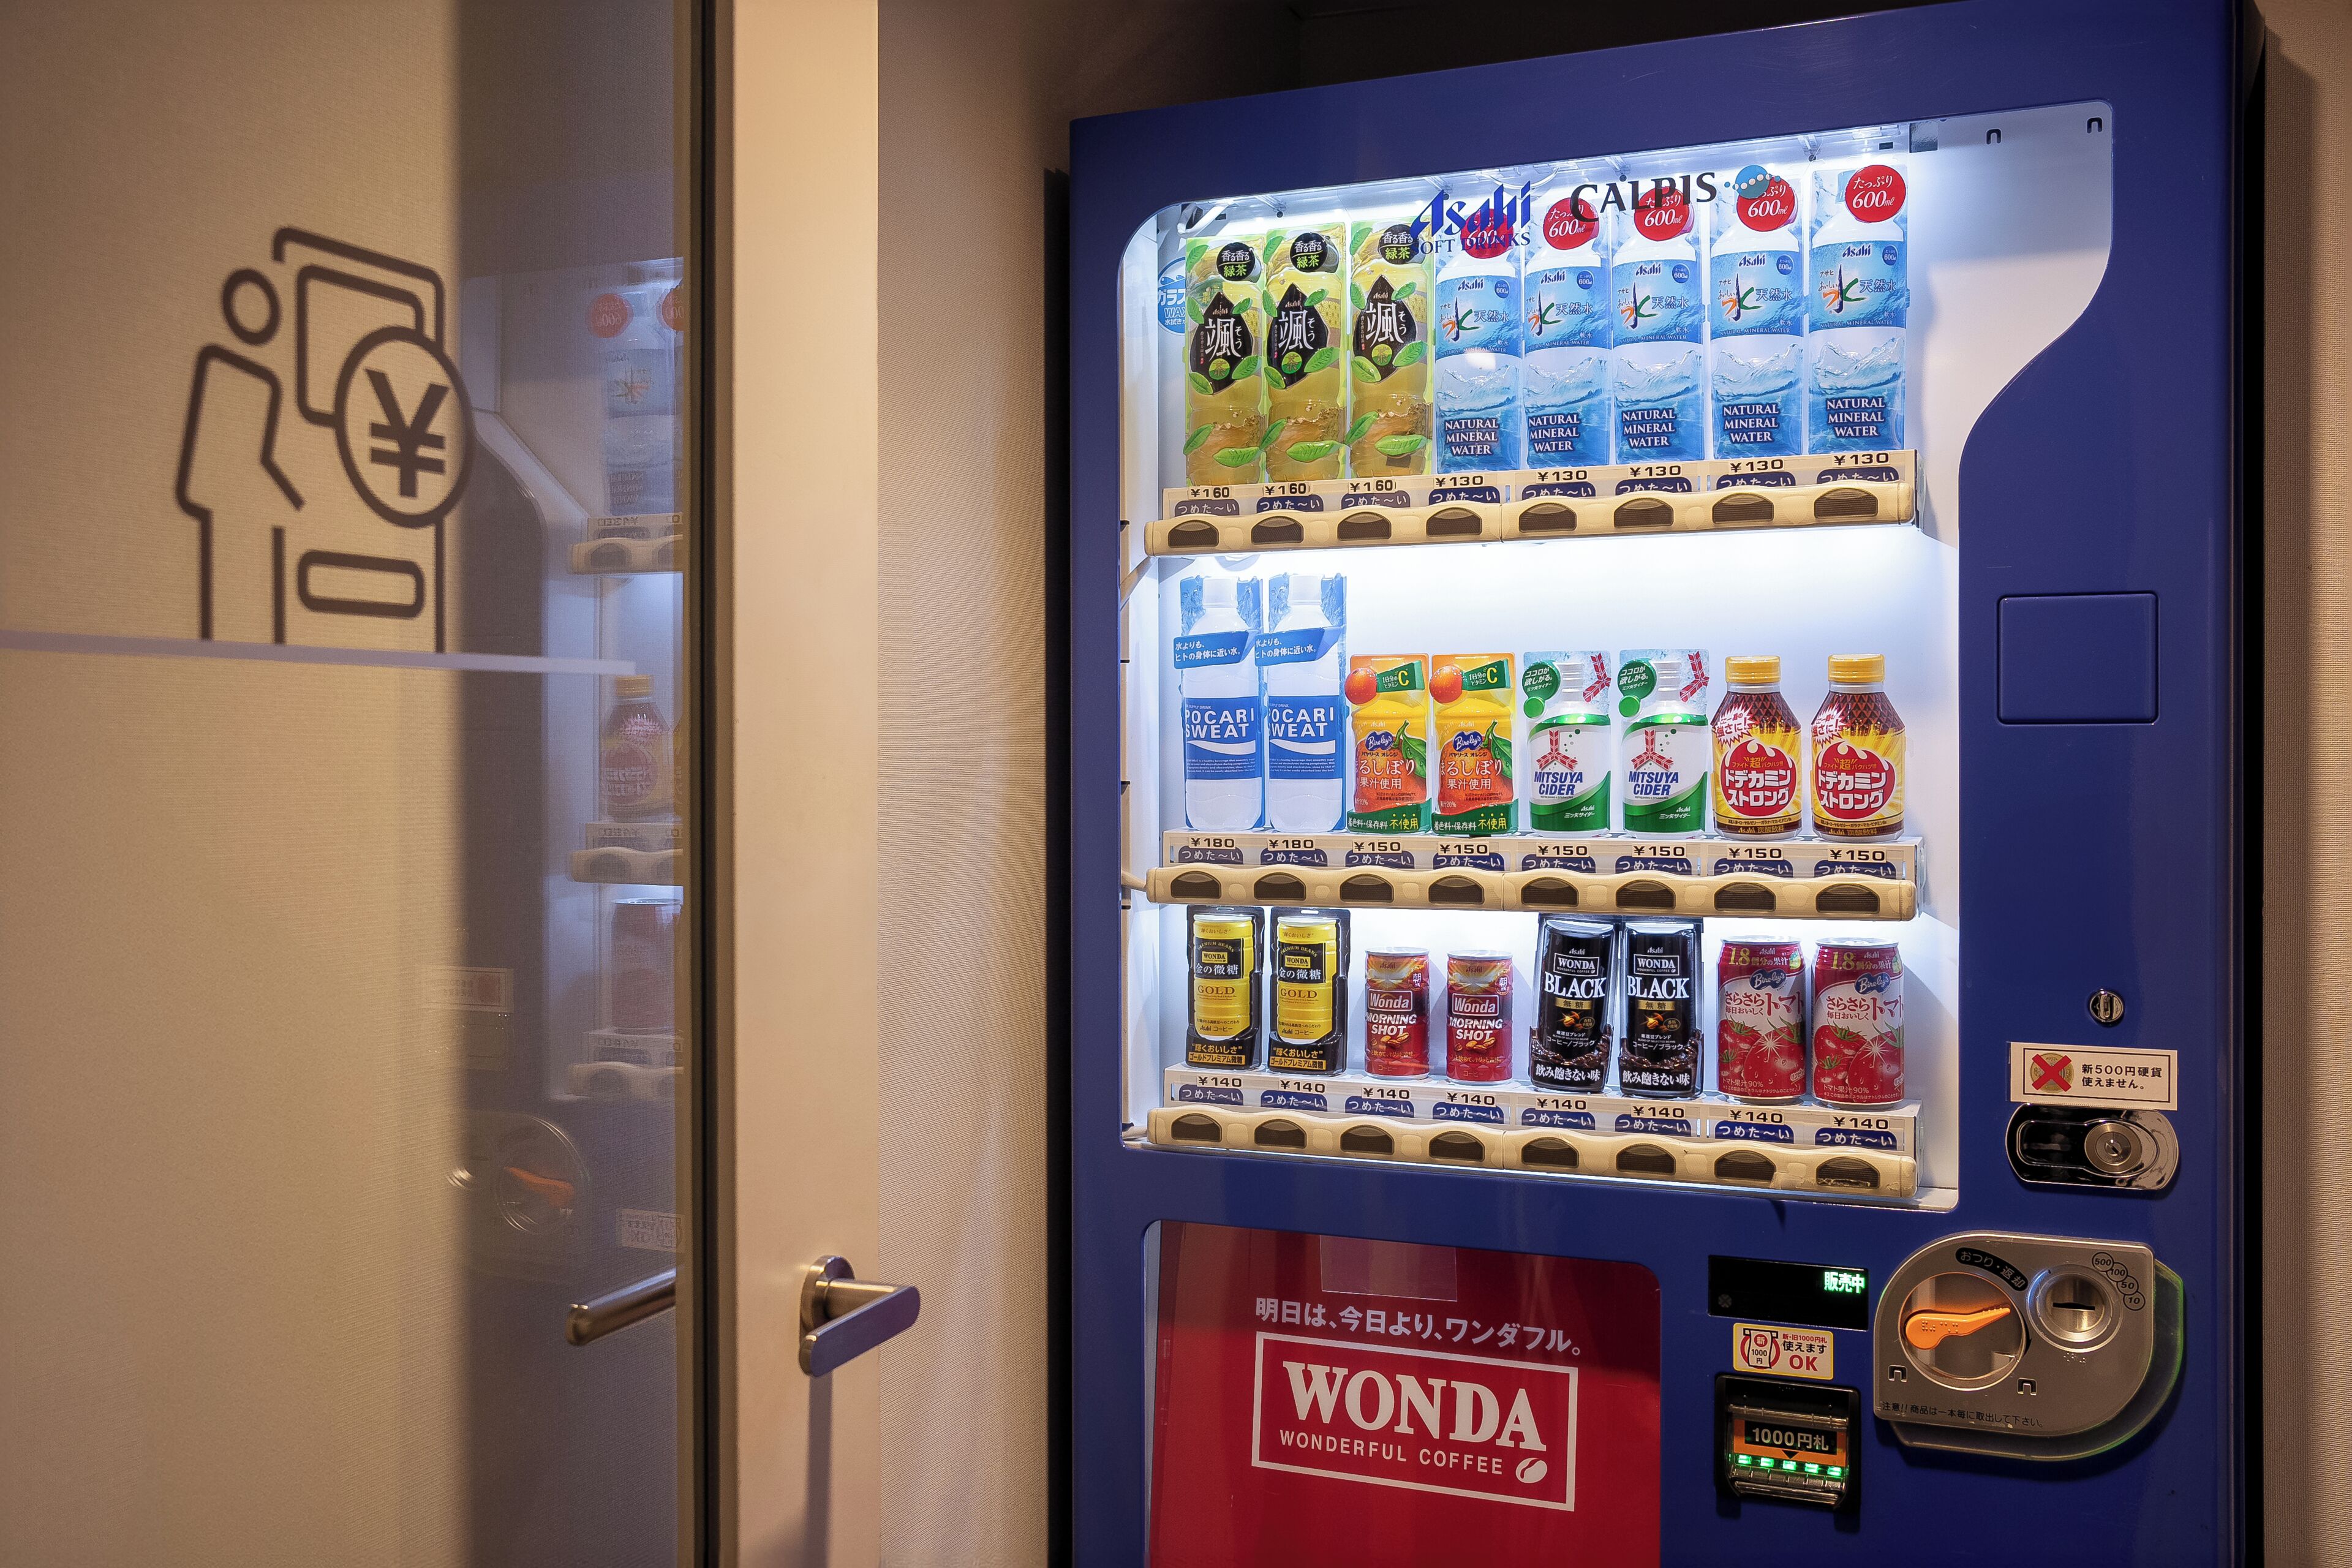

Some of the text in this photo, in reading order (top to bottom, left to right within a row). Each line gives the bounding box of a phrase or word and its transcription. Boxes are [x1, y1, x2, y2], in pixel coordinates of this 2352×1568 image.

[1853, 175, 1893, 190] たっぷり
[1570, 172, 1716, 222] CALPIS
[1409, 180, 1531, 238] Asahi
[1461, 232, 1531, 251] DRINKS
[1385, 247, 1410, 260] 緑茶
[1842, 244, 1871, 258] Asahi
[1296, 255, 1319, 269] 緑茶
[1738, 254, 1766, 267] Asahi
[1224, 264, 1247, 277] 緑茶
[1458, 279, 1484, 291] Asahi
[1826, 398, 1885, 410] NATURAL
[1623, 409, 1676, 422] NATURAL
[1723, 404, 1779, 417] NATURAL
[1529, 414, 1580, 427] NATURAL
[1724, 418, 1778, 430] MINERAL
[1828, 412, 1884, 424] MINERAL
[1445, 418, 1499, 431] NATURAL
[1623, 423, 1675, 435] MINERAL
[1446, 431, 1498, 443] MINERAL
[1530, 427, 1579, 440] MINERAL
[1730, 432, 1773, 442] WATER
[1834, 426, 1879, 437] WATER
[1534, 441, 1573, 453] WATER
[1629, 436, 1669, 448] WATER
[1452, 444, 1491, 456] WATER
[1730, 459, 1784, 472] ¥130
[1834, 453, 1889, 466] ¥130
[1537, 470, 1588, 481] ¥130
[1629, 465, 1682, 477] ¥130
[1349, 480, 1394, 492] ¥160
[1435, 475, 1483, 487] ¥130
[1191, 486, 1230, 498] ¥160
[1265, 482, 1307, 496] ¥160
[1186, 723, 1250, 739] SWEAT
[1534, 771, 1583, 783] MITSUYA
[1629, 771, 1679, 783] MITSUYA
[1725, 769, 1791, 788] ドデカミン
[1818, 771, 1886, 790] ドデカミン
[1360, 777, 1401, 790] 果汁使用
[1447, 778, 1491, 790] 果汁使用
[1539, 784, 1576, 795] CIDER
[1633, 784, 1671, 796] CIDER
[1727, 787, 1789, 807] ストロング
[1820, 790, 1883, 810] ストロング
[1191, 837, 1235, 848] ¥180
[1269, 839, 1314, 849] ¥180
[1354, 842, 1401, 852] ¥150
[1440, 844, 1488, 854] ¥150
[1537, 845, 1588, 856] ¥150
[1634, 846, 1686, 856] ¥150
[1728, 848, 1782, 859] ¥150
[1830, 850, 1886, 861] ¥150
[1196, 963, 1238, 975] 金の微糖
[1558, 957, 1596, 970] WONDA
[1637, 957, 1676, 969] WONDA
[1279, 967, 1321, 979] 金の微糖
[1198, 986, 1235, 994] GOLD
[1544, 971, 1607, 998] BLACK
[1627, 975, 1689, 998] BLACK
[1280, 989, 1317, 998] GOLD
[1370, 993, 1409, 1008] Wonda
[1454, 997, 1496, 1013] Wonda
[1366, 1012, 1417, 1024] MORNING
[1449, 1016, 1503, 1029] MORNING
[1371, 1025, 1406, 1036] SHOT
[1456, 1029, 1493, 1041] SHOT
[2081, 1063, 2162, 1079] 新500円硬貨
[1198, 1076, 1242, 1087] ¥140
[1280, 1080, 1325, 1093] ¥140
[1363, 1087, 1410, 1099] ¥140
[1447, 1092, 1495, 1106] ¥140
[1537, 1098, 1587, 1110] ¥140
[1633, 1106, 1685, 1118] ¥140
[1730, 1110, 1783, 1123] ¥140
[1833, 1117, 1888, 1130] ¥140
[1823, 1271, 1864, 1294] 販売中
[1783, 1340, 1827, 1354] 使えます
[1789, 1354, 1818, 1371] OK
[1283, 1360, 1547, 1452] WONDA
[1752, 1427, 1829, 1452] 1000円札
[1280, 1430, 1502, 1475] WONDERFUL COFFEE
